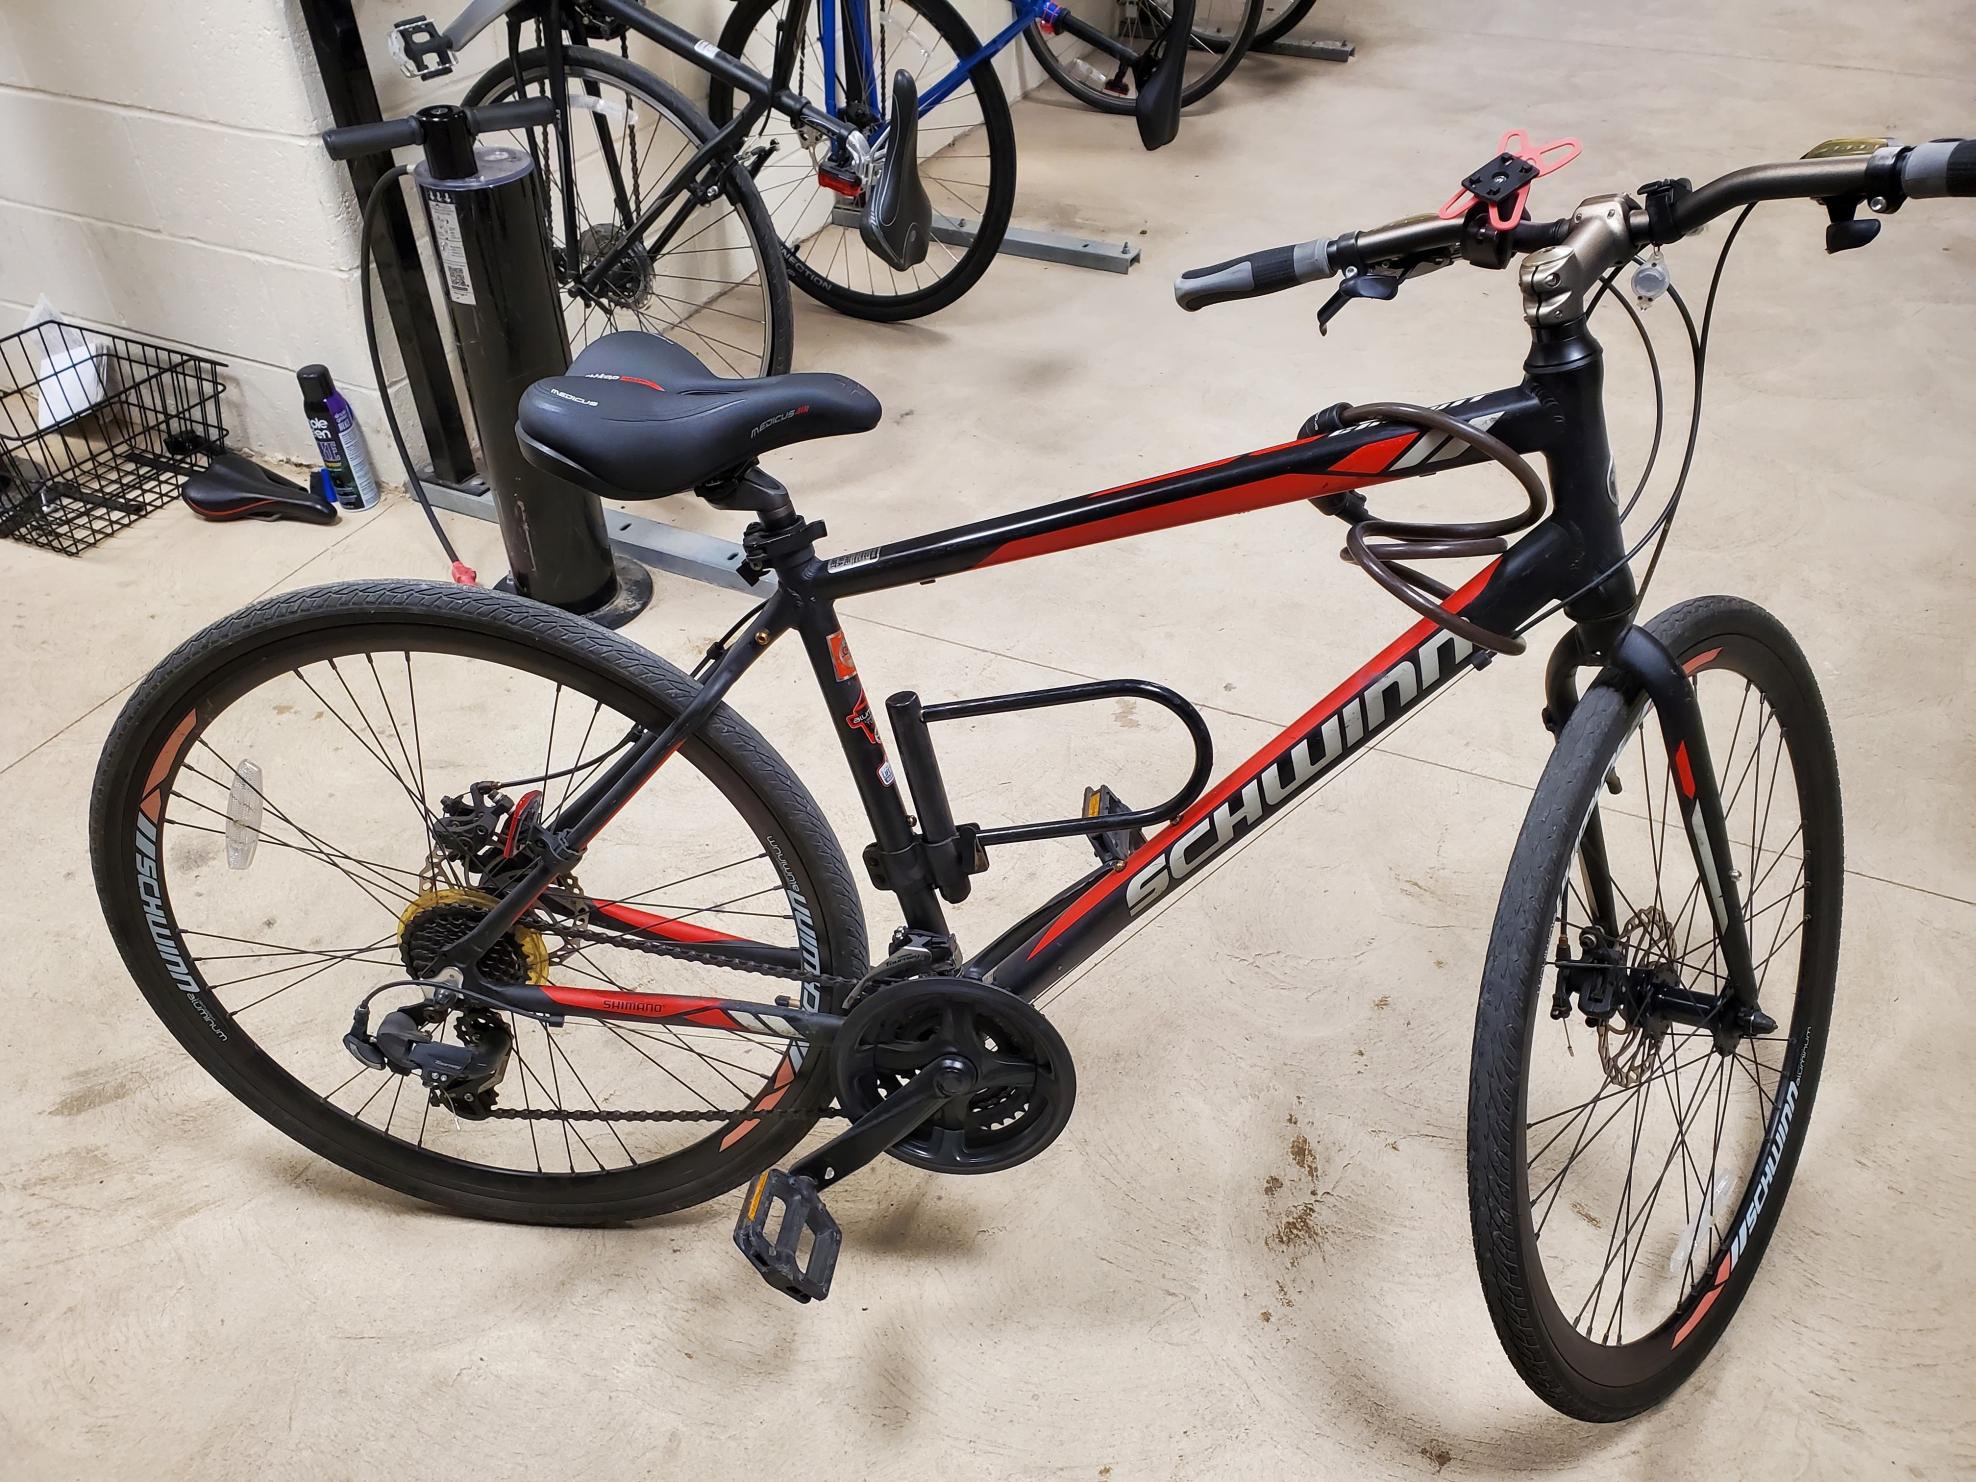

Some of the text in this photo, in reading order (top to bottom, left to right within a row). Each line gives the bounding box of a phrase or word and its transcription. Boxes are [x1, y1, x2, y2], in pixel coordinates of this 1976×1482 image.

[781, 245, 833, 291] NECTION
[550, 388, 599, 407] MEDICUS
[750, 409, 795, 440] MEDICUS
[766, 835, 800, 893] aluminum
[186, 991, 229, 1043] aluminum
[603, 1000, 662, 1013] SHIMANO
[1795, 1025, 1813, 1088] aluminum
